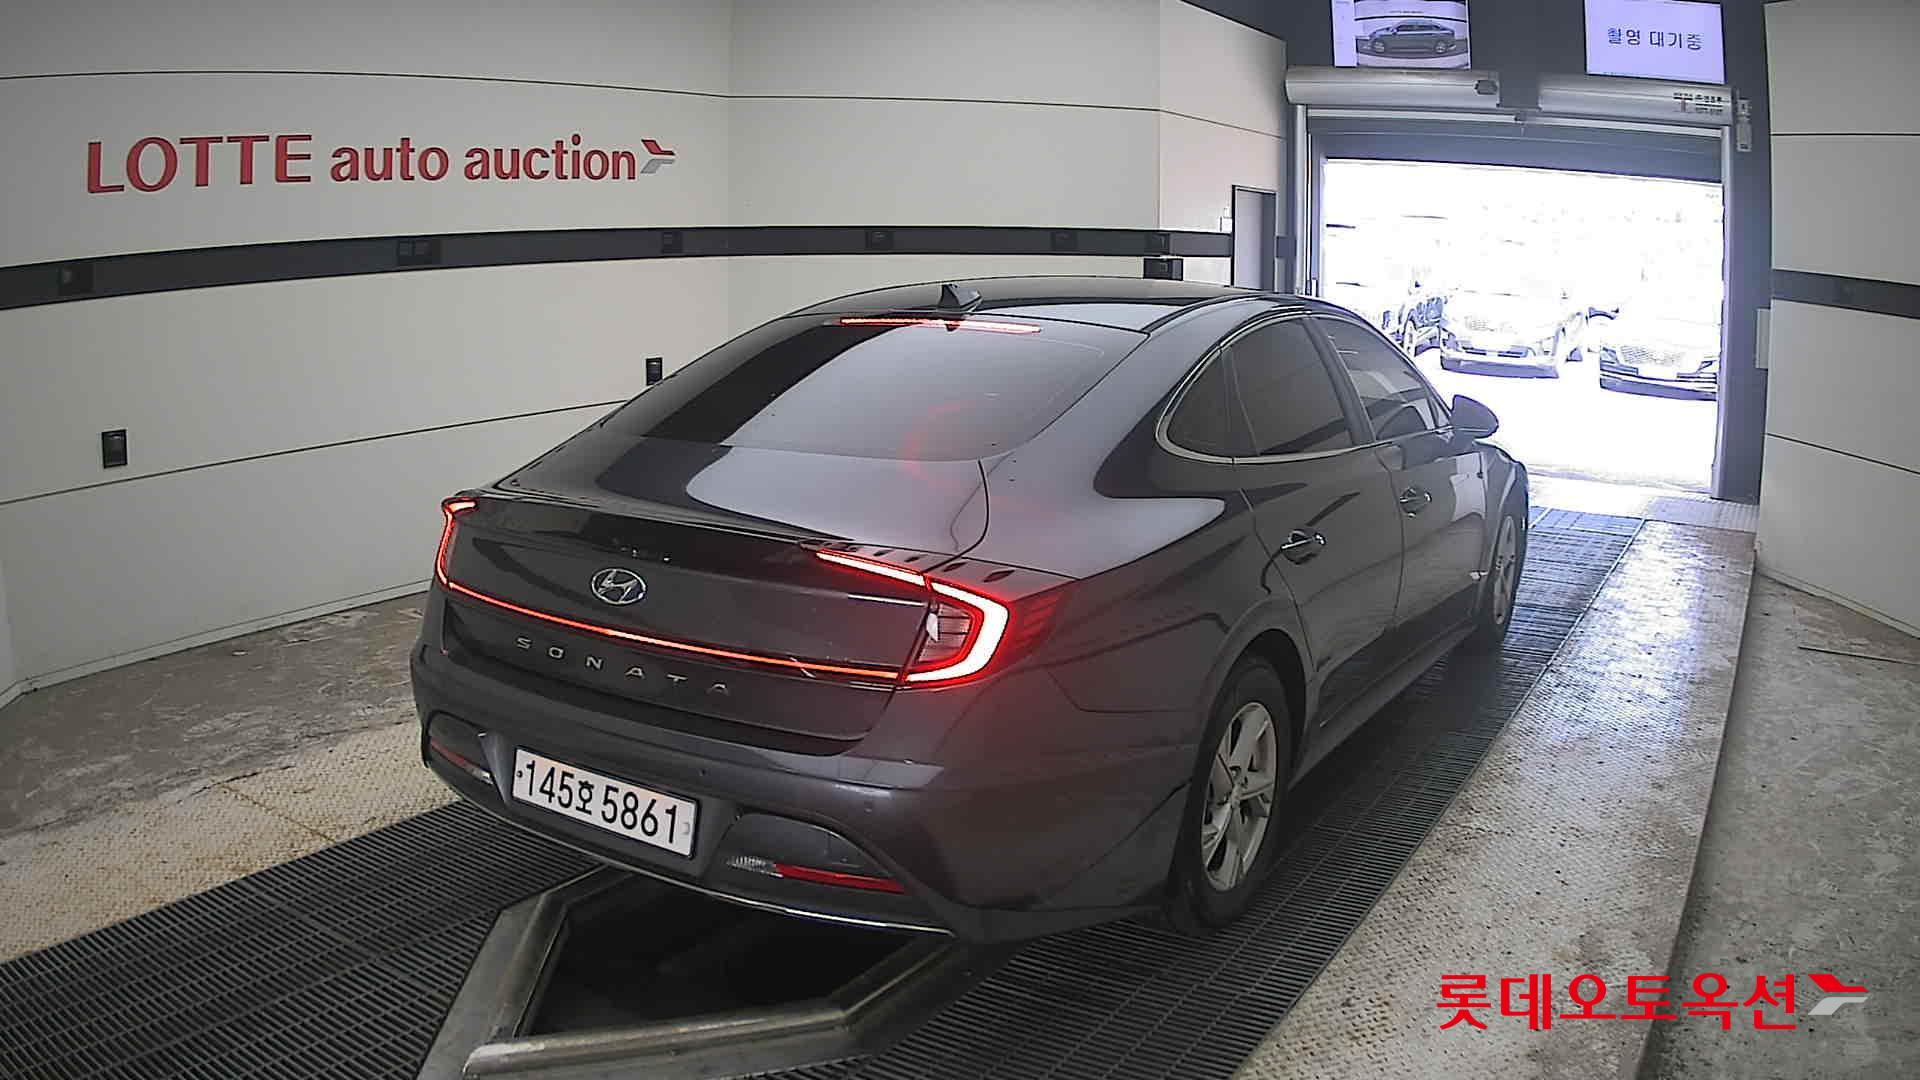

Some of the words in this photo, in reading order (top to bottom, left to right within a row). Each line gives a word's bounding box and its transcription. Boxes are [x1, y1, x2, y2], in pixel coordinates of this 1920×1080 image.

[87, 134, 312, 193] LOTTE
[330, 137, 449, 182] auto
[464, 134, 636, 180] auction
[515, 636, 729, 696] SONATA
[526, 760, 595, 815] 145호
[601, 785, 678, 844] 5861
